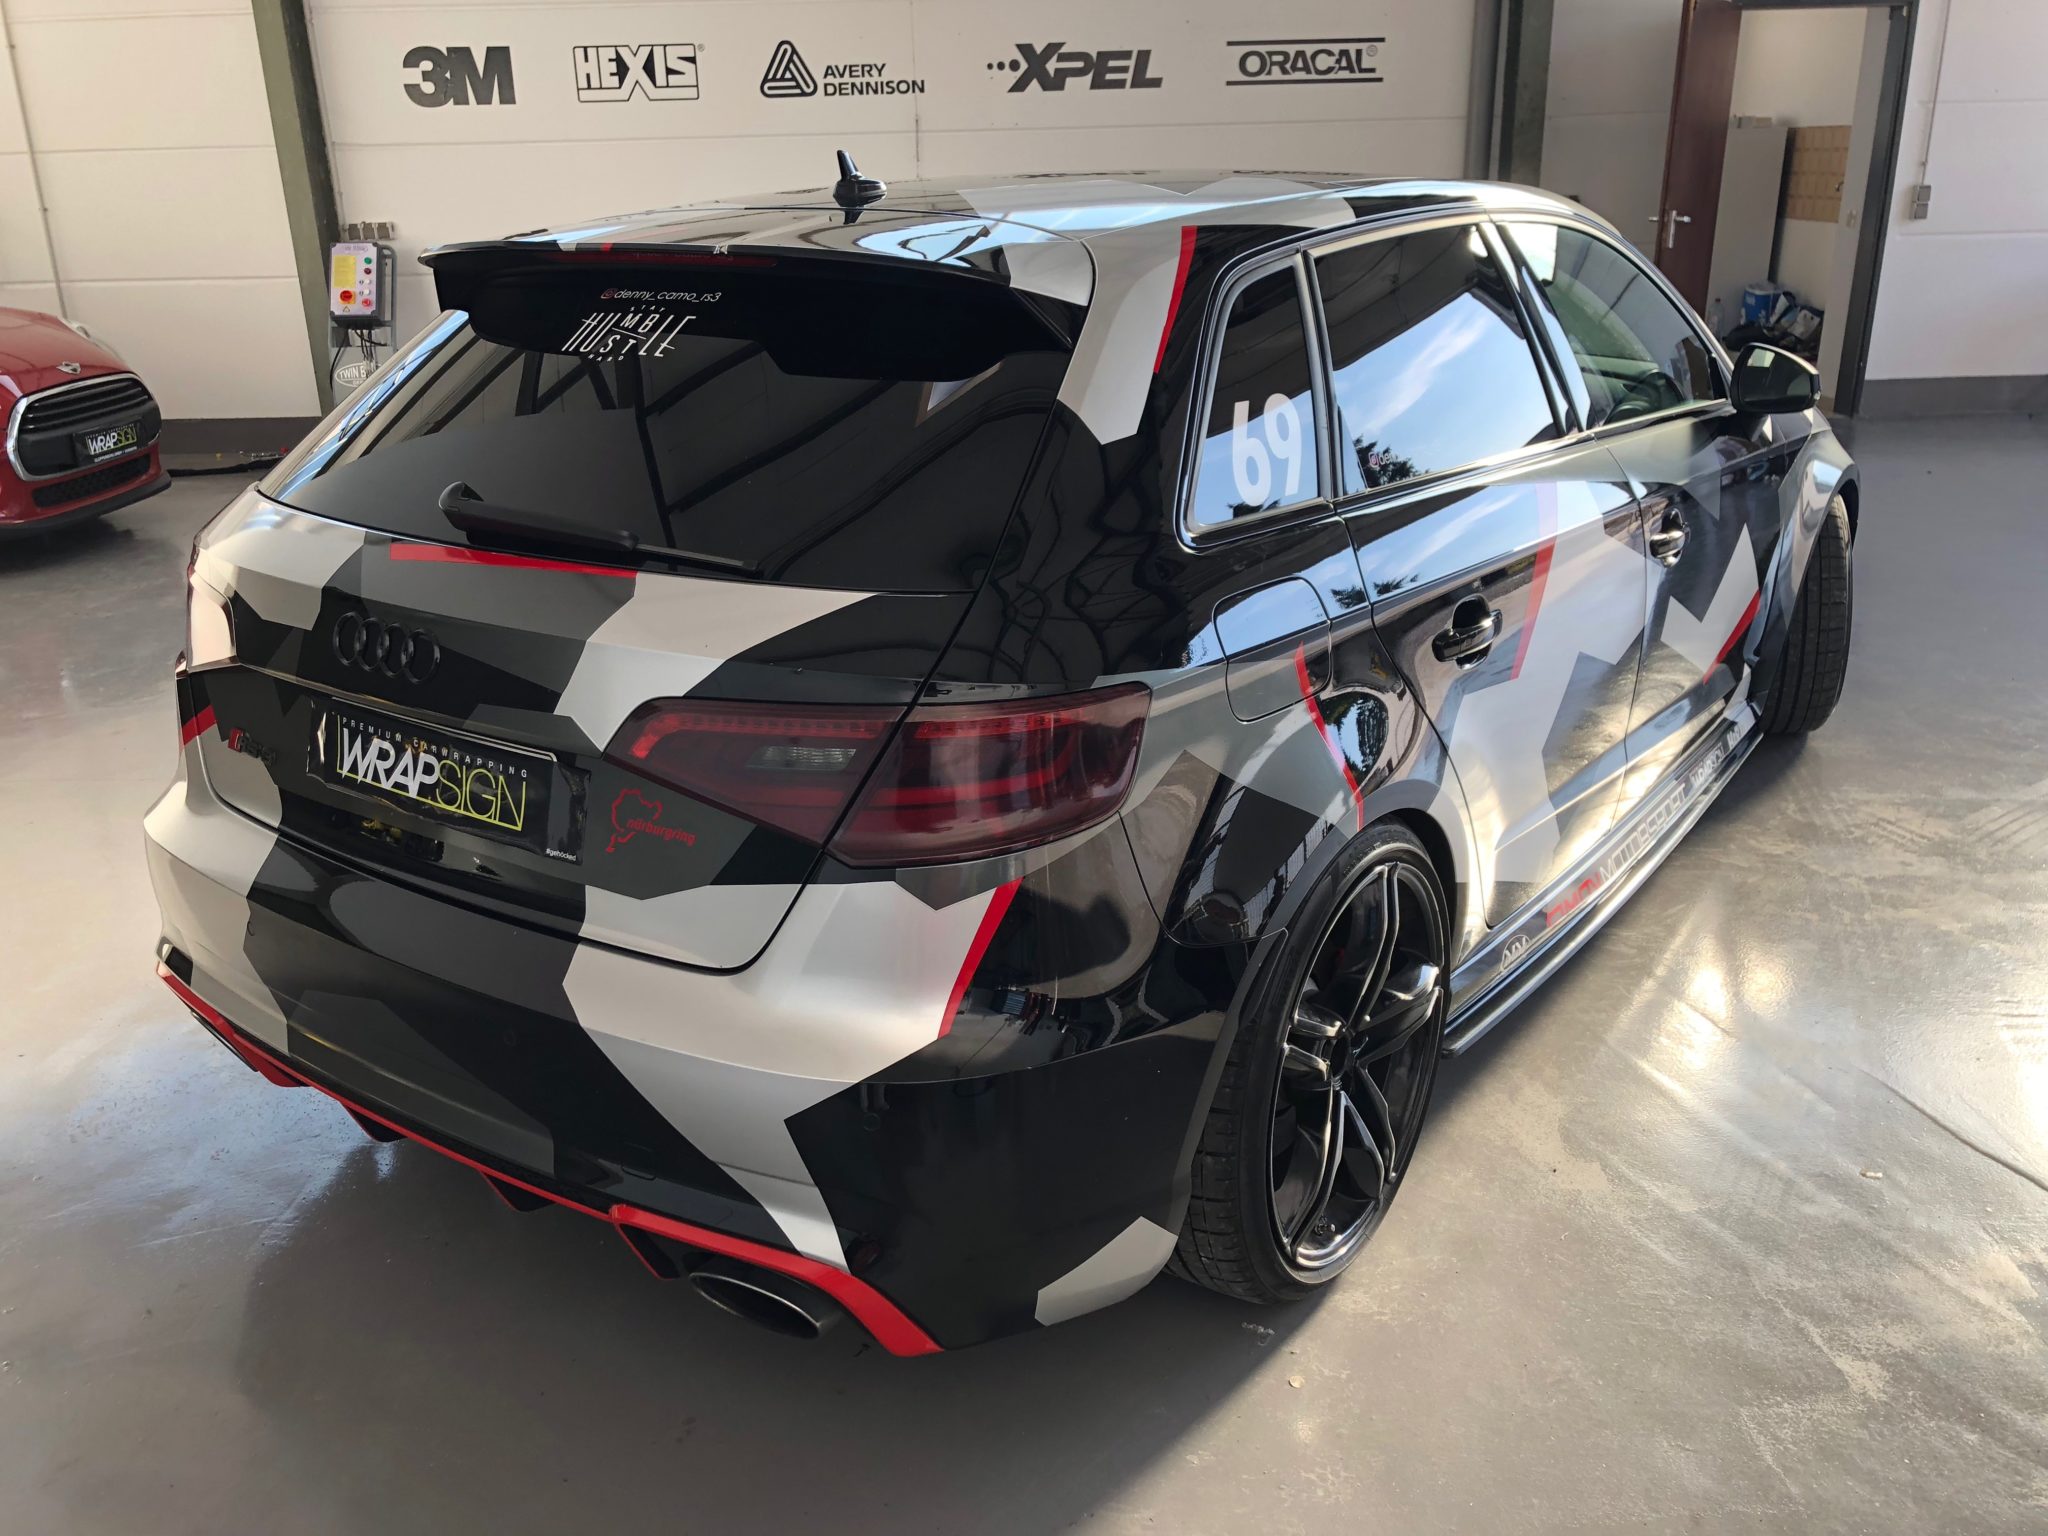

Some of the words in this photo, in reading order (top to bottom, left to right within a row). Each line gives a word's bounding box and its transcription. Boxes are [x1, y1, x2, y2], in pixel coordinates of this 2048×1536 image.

[402, 46, 517, 107] 3M
[823, 62, 887, 79] AVERY
[1007, 42, 1163, 93] XPEL
[823, 79, 926, 97] DENNISON
[1232, 393, 1302, 507] 69
[342, 716, 402, 743] PREMIUM
